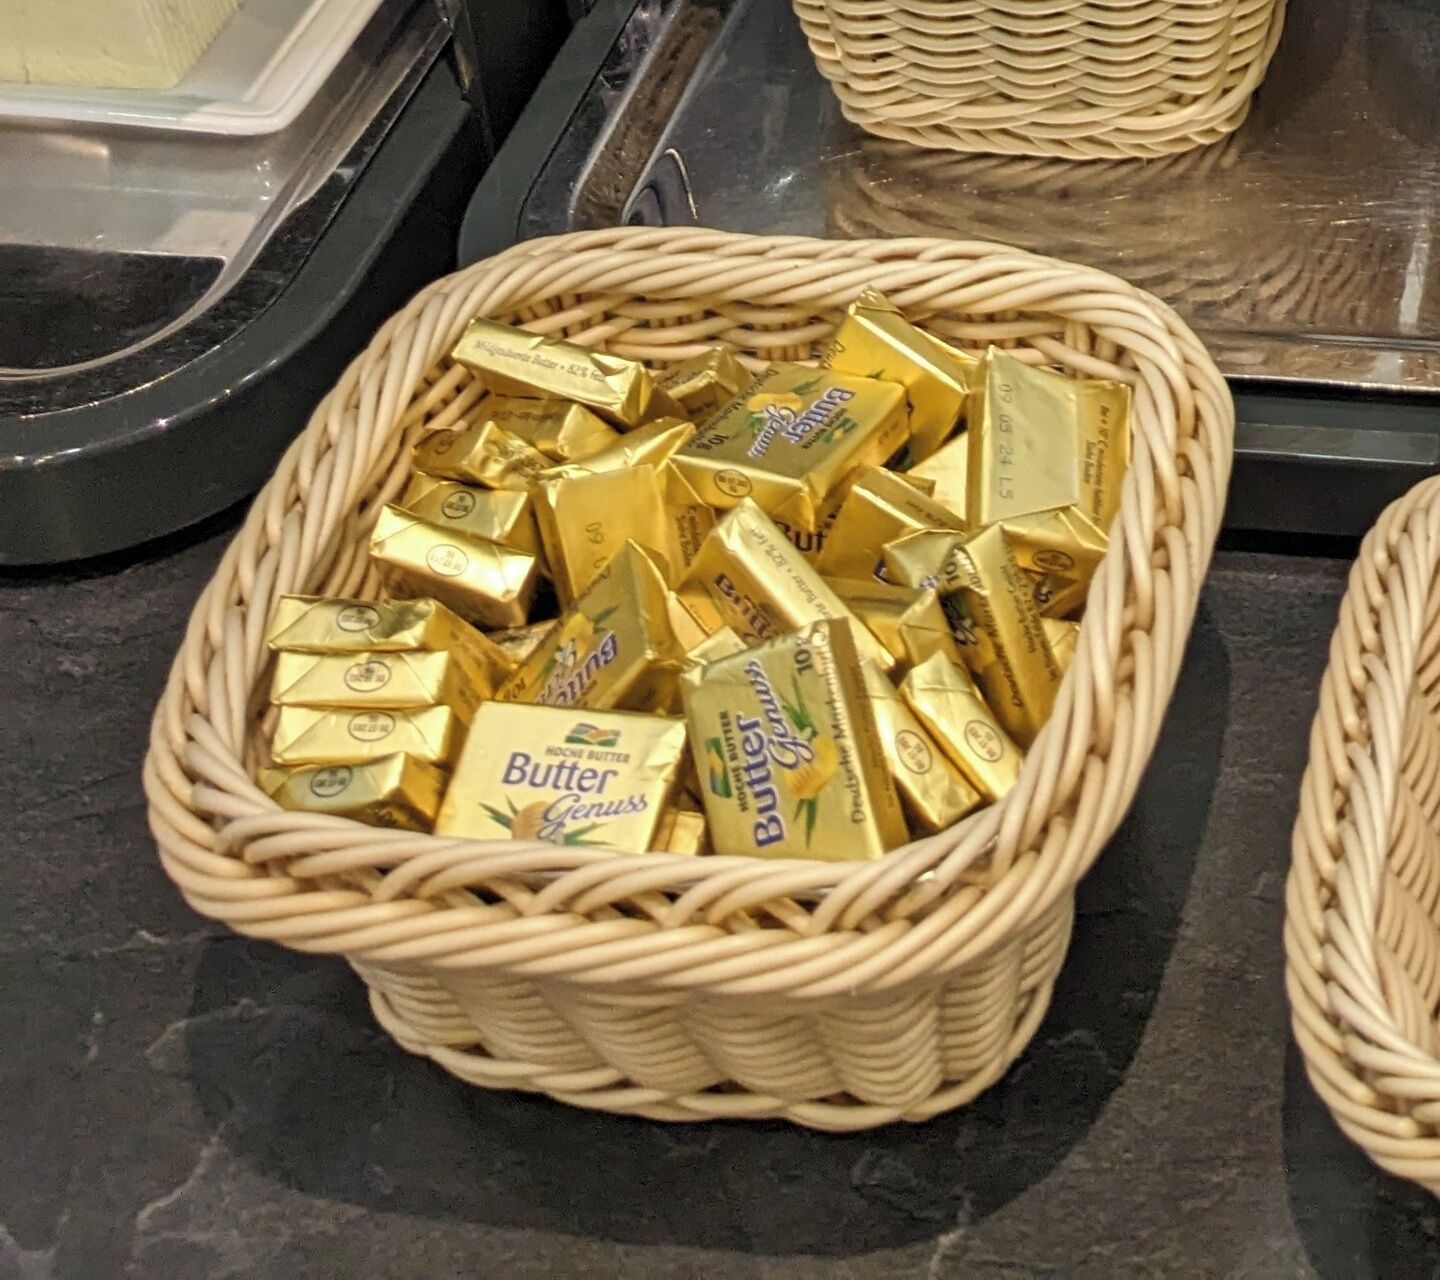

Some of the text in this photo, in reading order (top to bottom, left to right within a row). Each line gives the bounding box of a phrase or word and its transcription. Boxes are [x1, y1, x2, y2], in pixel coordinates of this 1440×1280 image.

[533, 350, 560, 368] Butter
[566, 361, 588, 380] 82%
[747, 406, 796, 462] Genuss
[782, 387, 856, 443] Butter
[789, 572, 818, 605] Butter
[794, 647, 814, 673] 10
[743, 657, 814, 770] Genuss
[502, 751, 618, 795] Butter
[545, 744, 631, 764] HOCHE BUTTER
[718, 710, 747, 813] HOCHE BUTTER
[737, 712, 786, 848] Butter
[837, 754, 865, 825] Deutsche
[536, 793, 649, 840] Genuss
